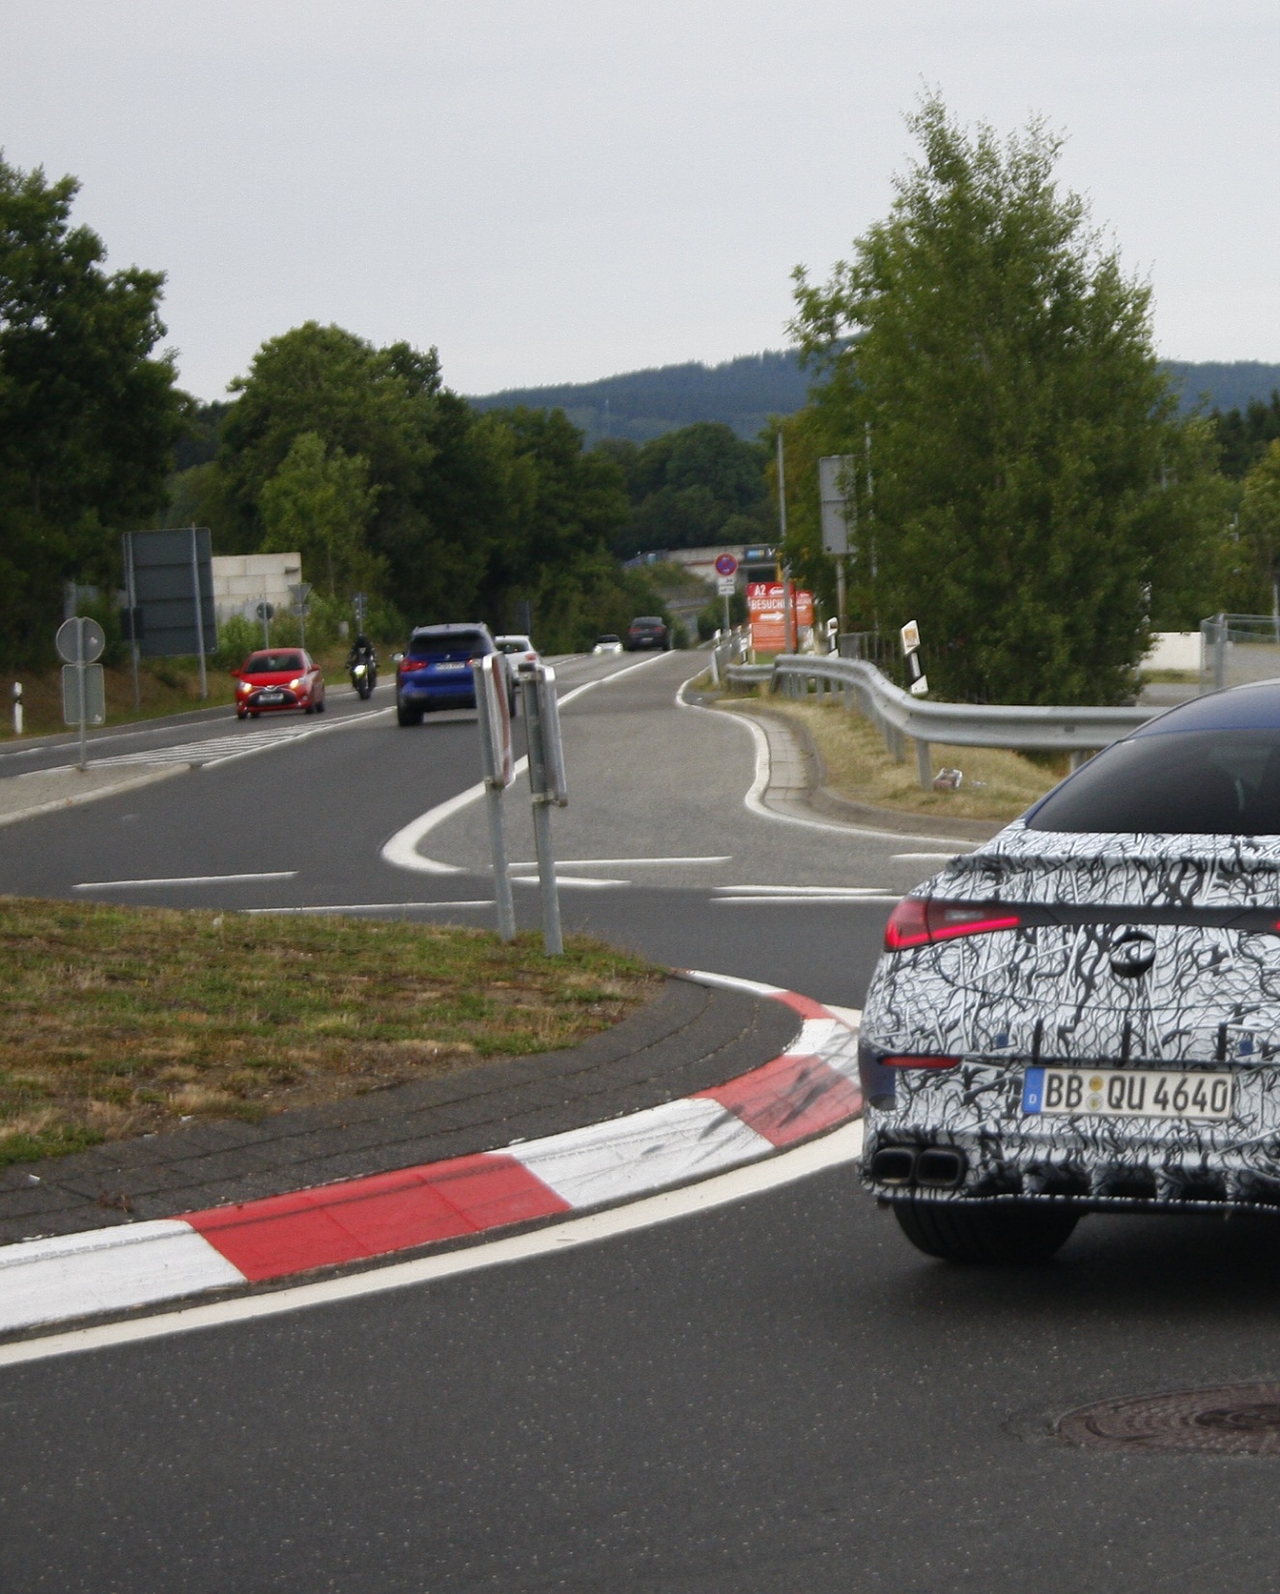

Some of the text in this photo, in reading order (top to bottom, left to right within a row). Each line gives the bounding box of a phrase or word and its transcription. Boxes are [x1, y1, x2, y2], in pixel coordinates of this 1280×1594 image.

[754, 584, 767, 596] A2
[751, 598, 794, 610] BESUCHR
[1045, 1073, 1084, 1108] BB
[1107, 1075, 1147, 1110] QU
[1153, 1077, 1228, 1113] 4640
